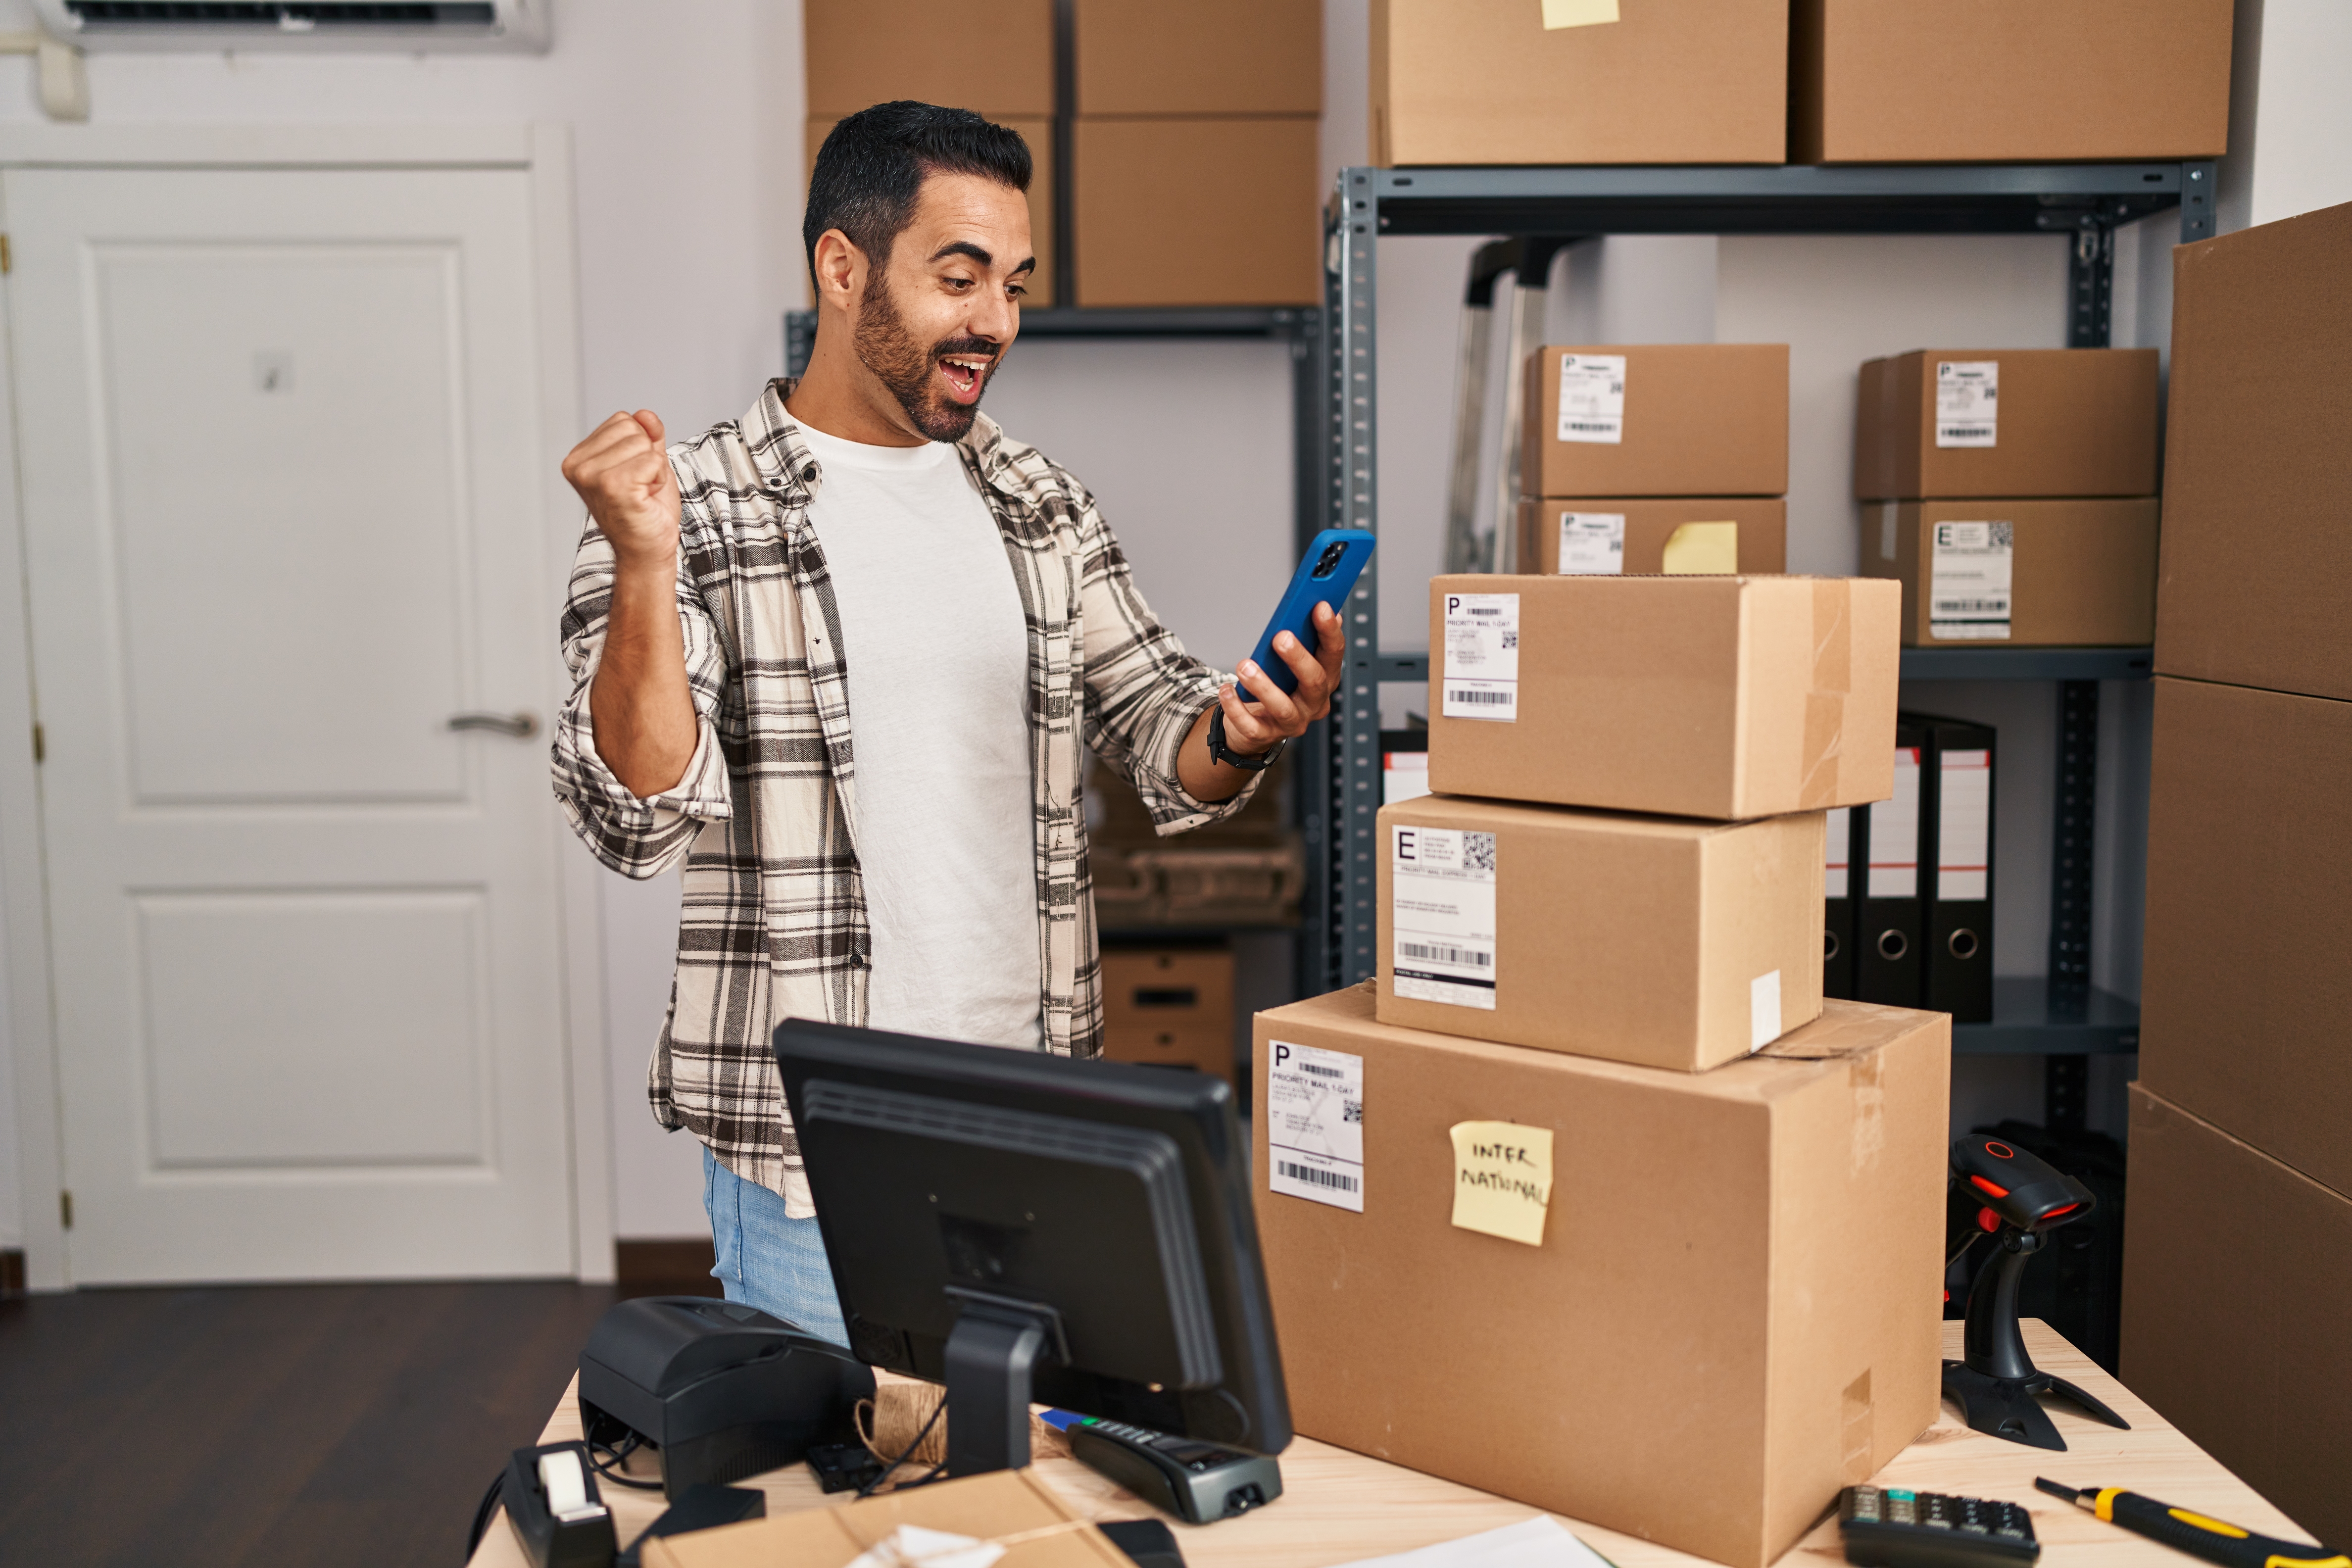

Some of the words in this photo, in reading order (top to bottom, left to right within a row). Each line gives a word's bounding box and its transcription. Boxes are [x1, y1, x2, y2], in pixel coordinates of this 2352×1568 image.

[1938, 525, 1952, 545] E
[1449, 597, 1460, 615] P
[1399, 832, 1415, 860] E
[1276, 1044, 1289, 1066] P
[1272, 1072, 1309, 1085] PRIORITY
[1311, 1080, 1329, 1089] MAIL
[1332, 1084, 1355, 1095] 1-DAY
[1473, 1143, 1538, 1169] INTER
[1462, 1169, 1548, 1207] NATIONAL
